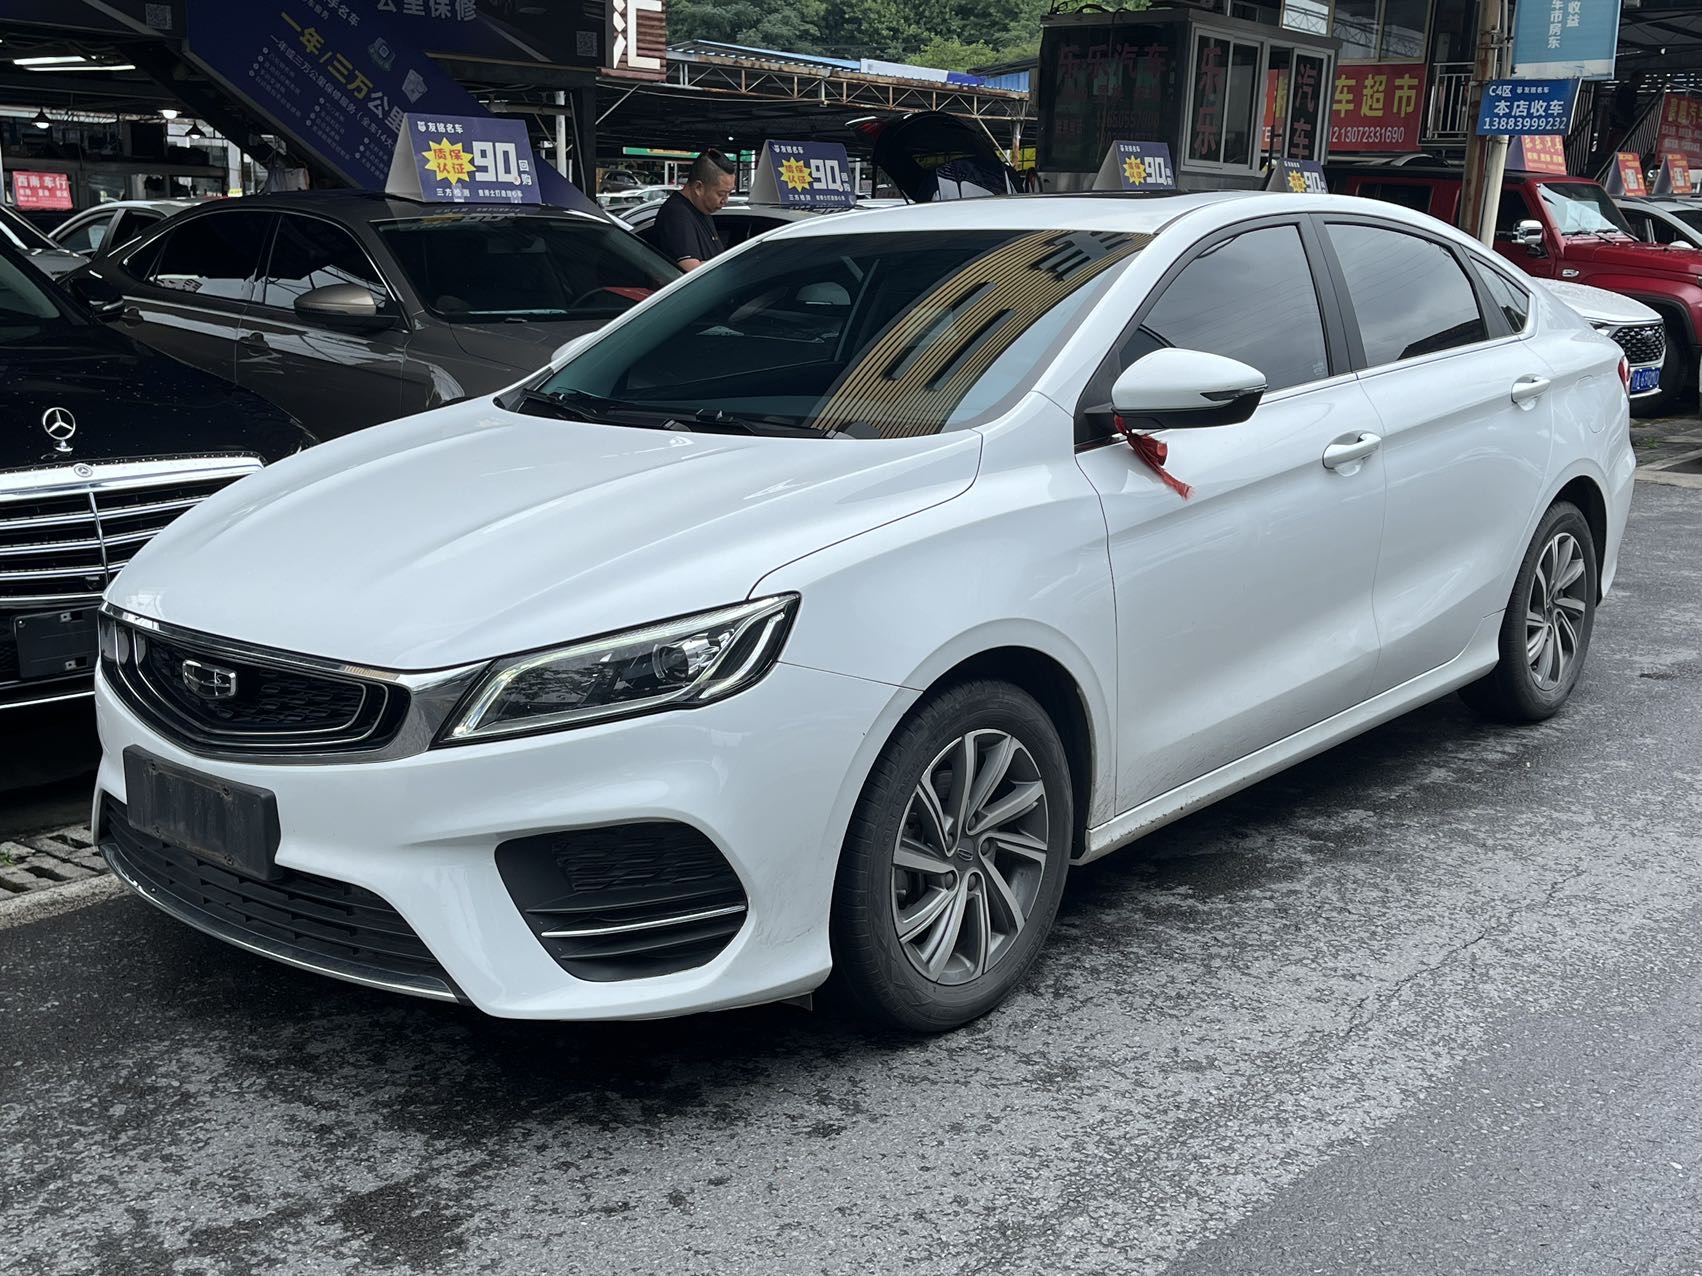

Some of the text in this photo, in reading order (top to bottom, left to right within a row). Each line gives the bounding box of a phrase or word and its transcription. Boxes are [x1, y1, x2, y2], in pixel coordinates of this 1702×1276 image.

[376, 0, 477, 21] 公里保修
[1489, 85, 1512, 97] C4区
[1494, 99, 1565, 116] 本店收车
[1483, 116, 1567, 130] 13883999232
[1340, 126, 1405, 143] 13072331690
[433, 147, 464, 161] 质保
[472, 140, 519, 182] 90
[437, 162, 466, 175] 认证
[809, 159, 842, 190] 90
[1144, 156, 1166, 184] 90
[1303, 171, 1321, 193] 90
